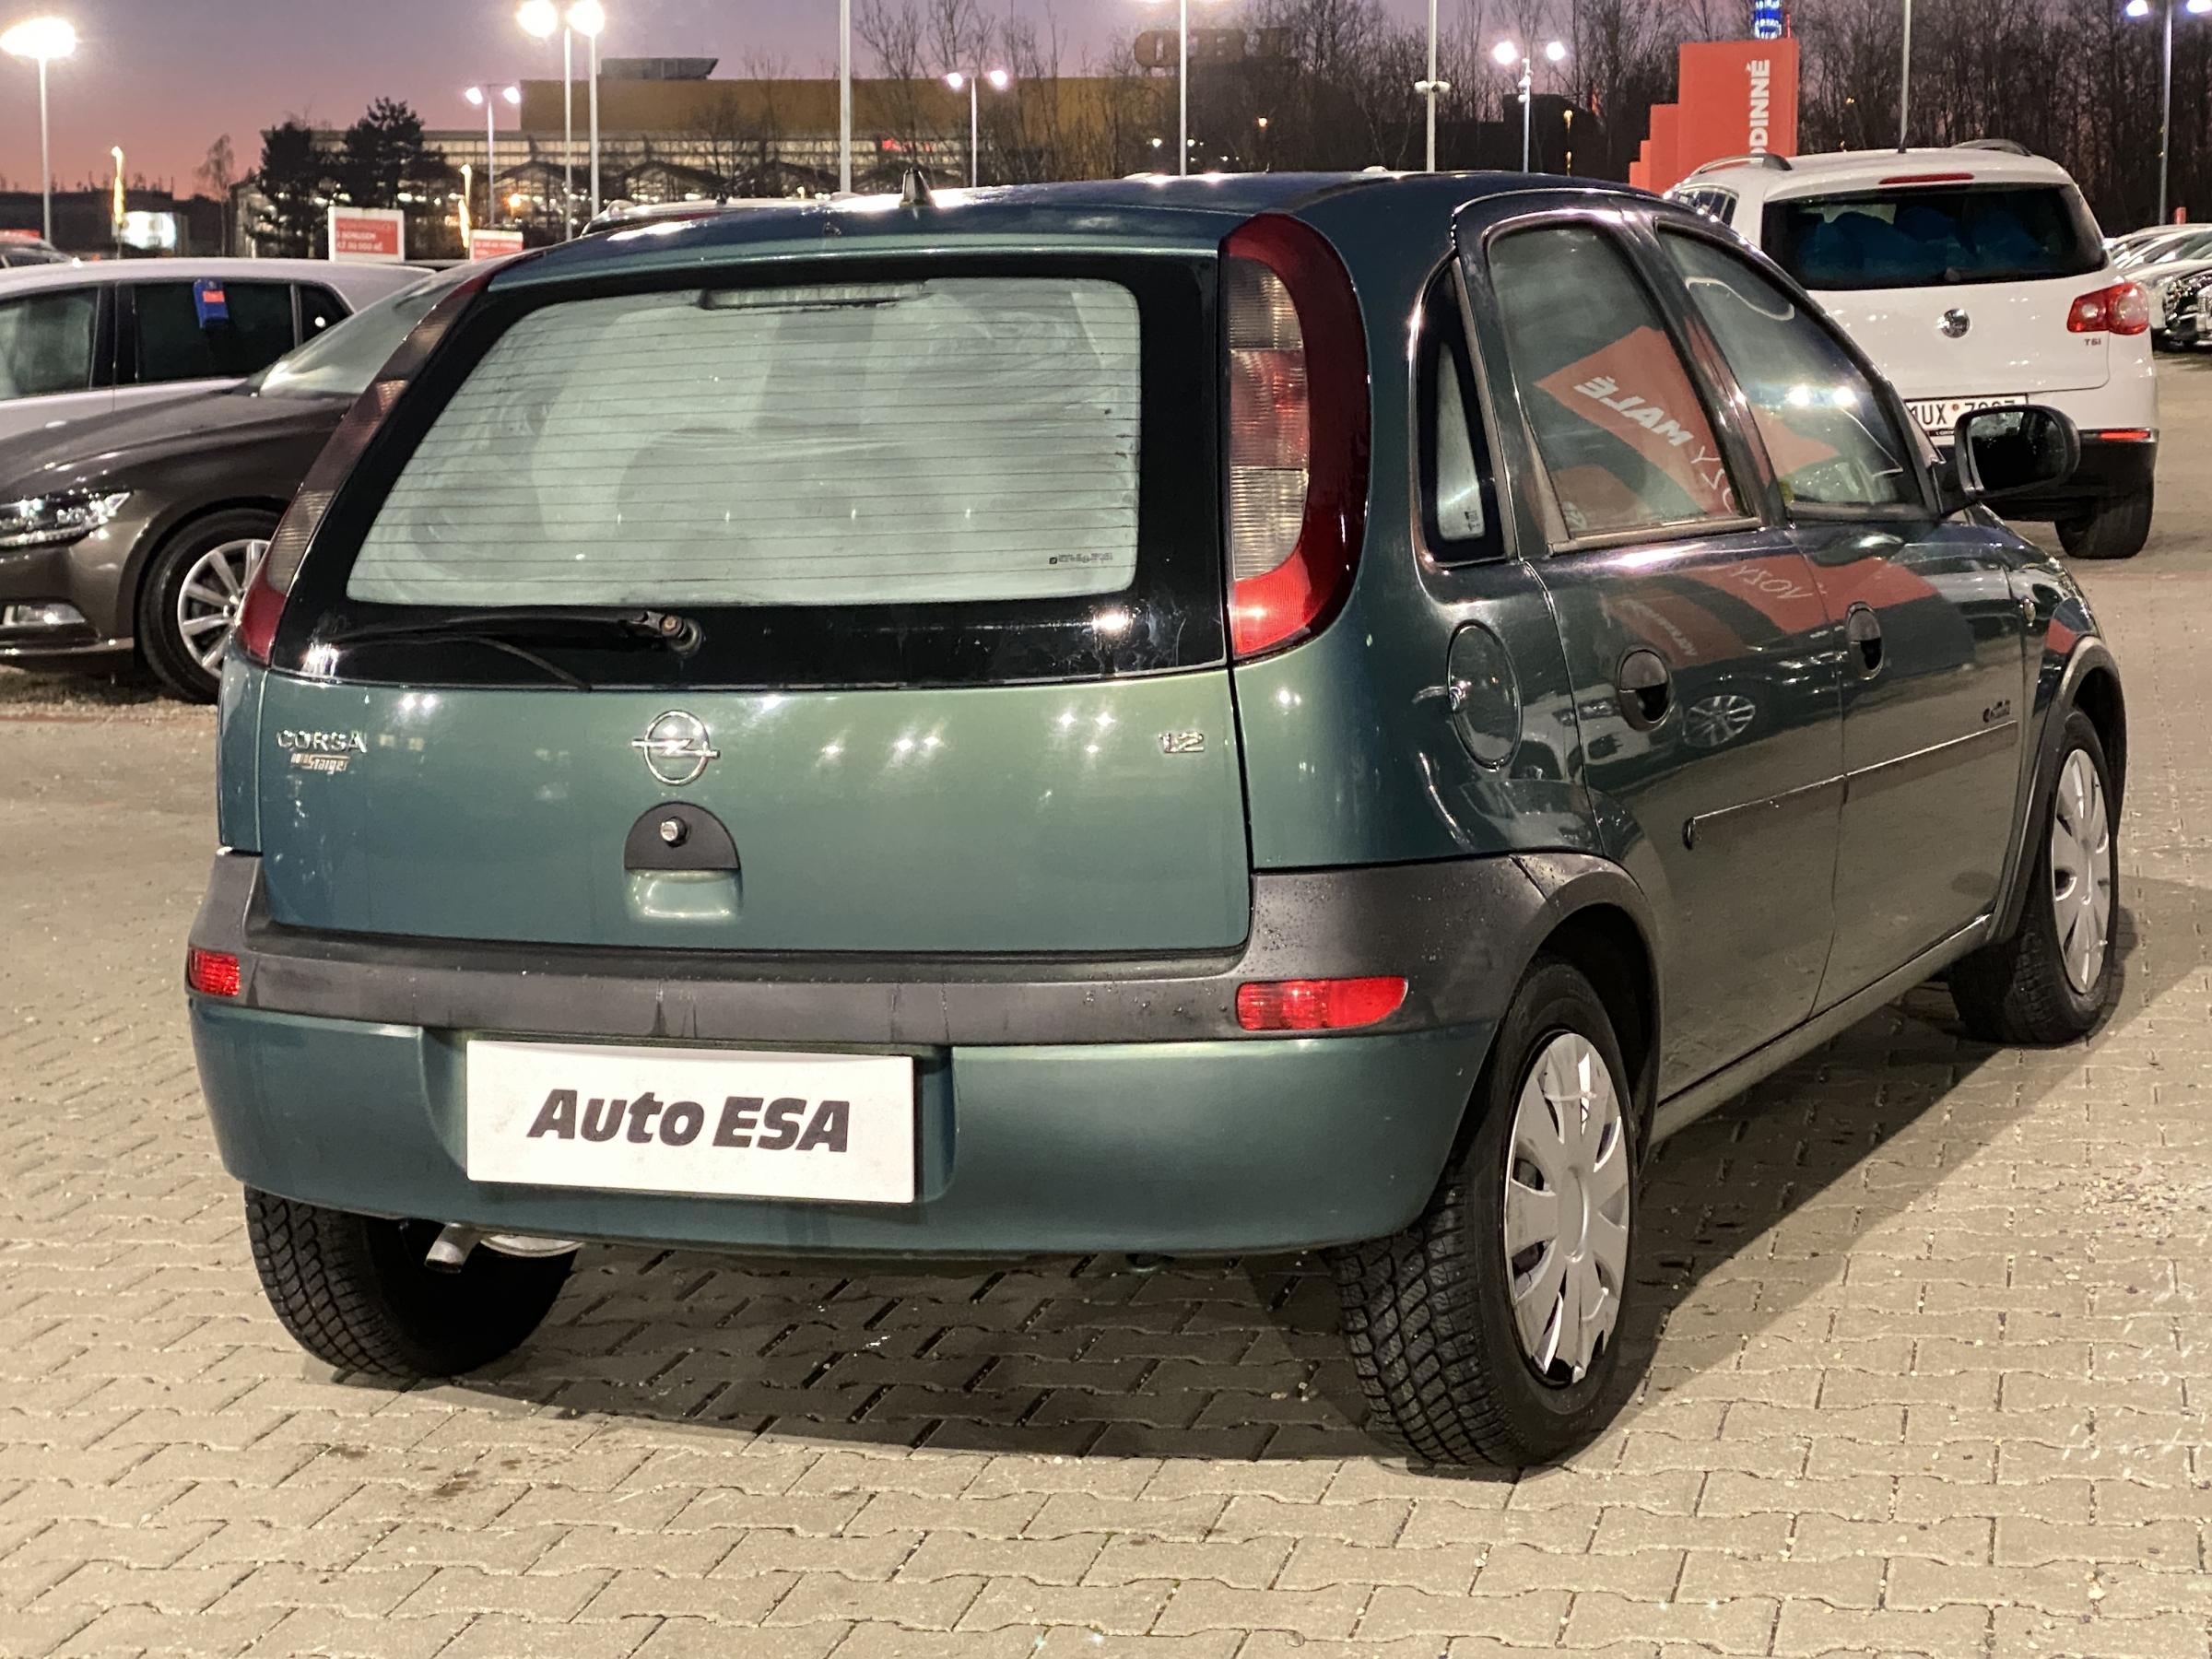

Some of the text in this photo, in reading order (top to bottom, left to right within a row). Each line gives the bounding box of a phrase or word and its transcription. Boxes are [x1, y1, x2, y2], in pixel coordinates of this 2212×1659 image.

[277, 729, 368, 753] CORSA
[526, 1088, 850, 1152] Auto ESA
